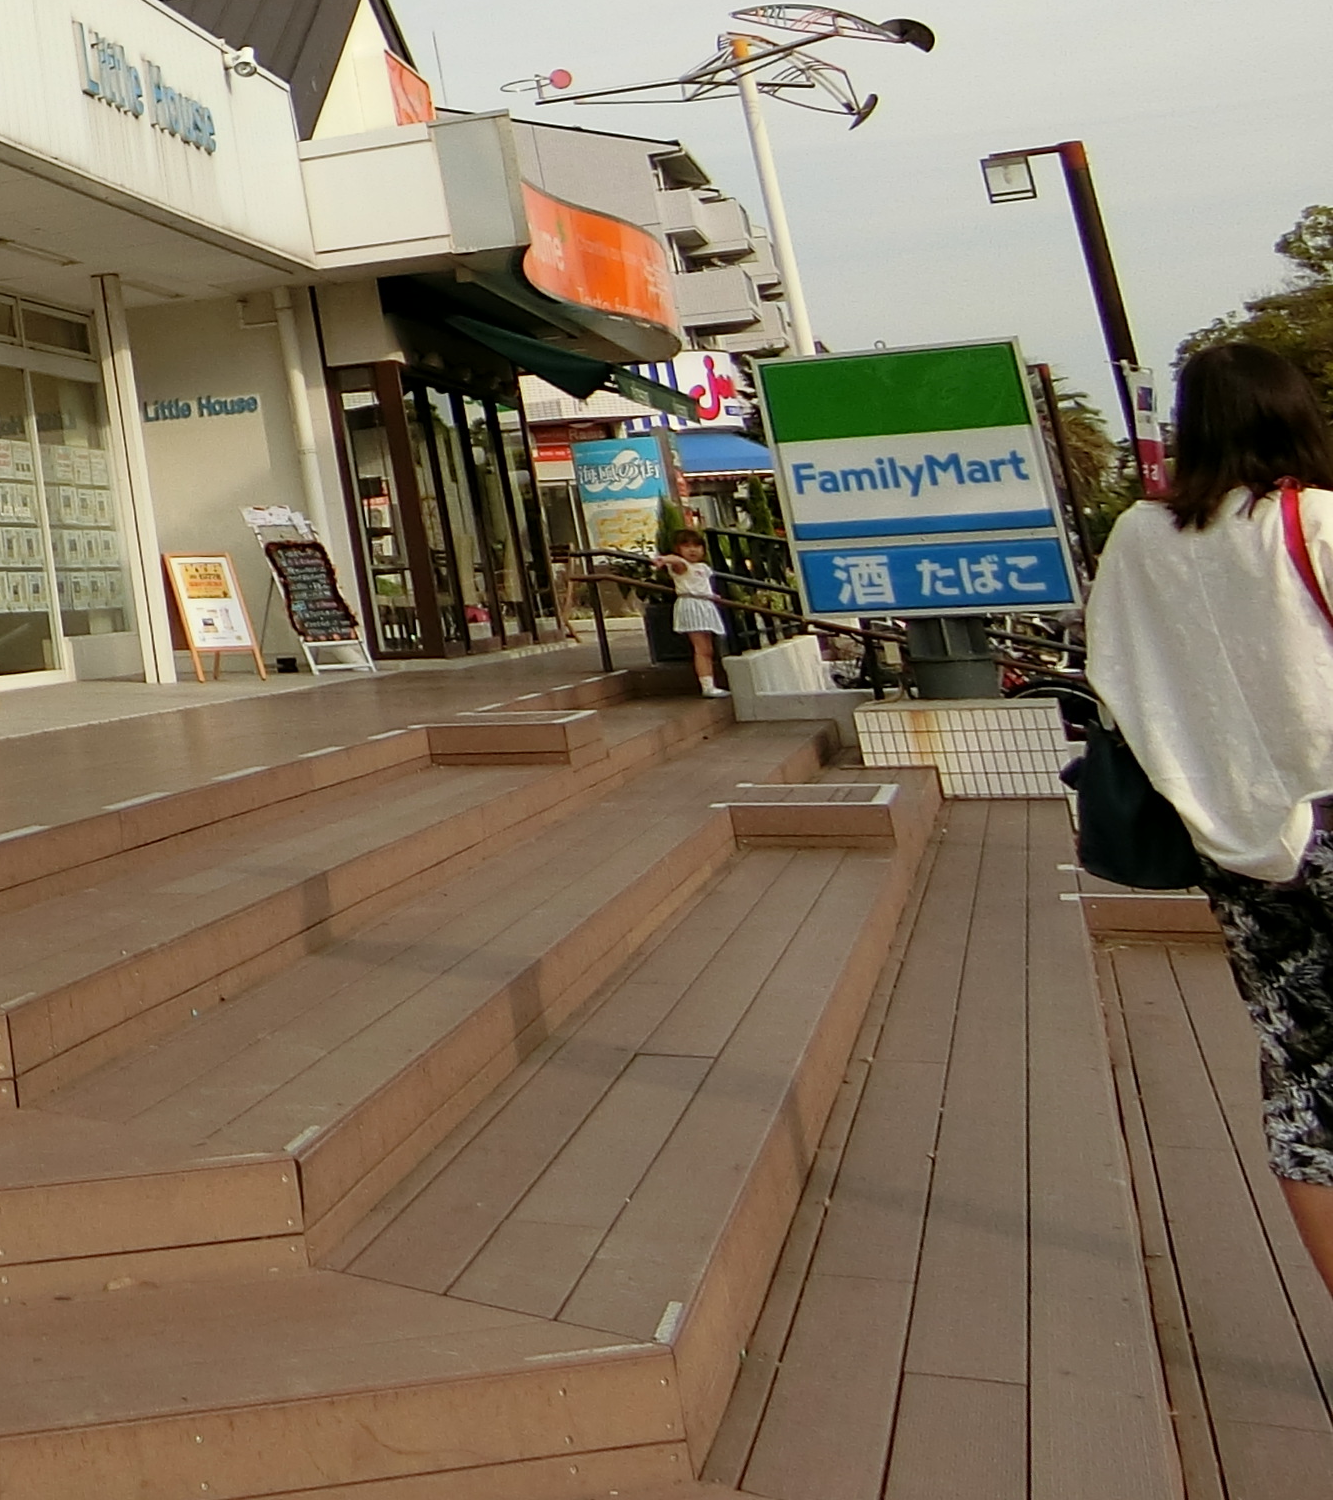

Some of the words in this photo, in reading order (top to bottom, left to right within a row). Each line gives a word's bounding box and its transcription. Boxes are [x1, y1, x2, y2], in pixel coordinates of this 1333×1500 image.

[72, 19, 144, 119] Little
[144, 398, 191, 422] Little
[197, 396, 258, 418] House
[577, 457, 661, 485] 海風の街
[791, 449, 1031, 497] FamilyMart
[833, 555, 897, 604] 酒
[916, 554, 1047, 597] たばこ
